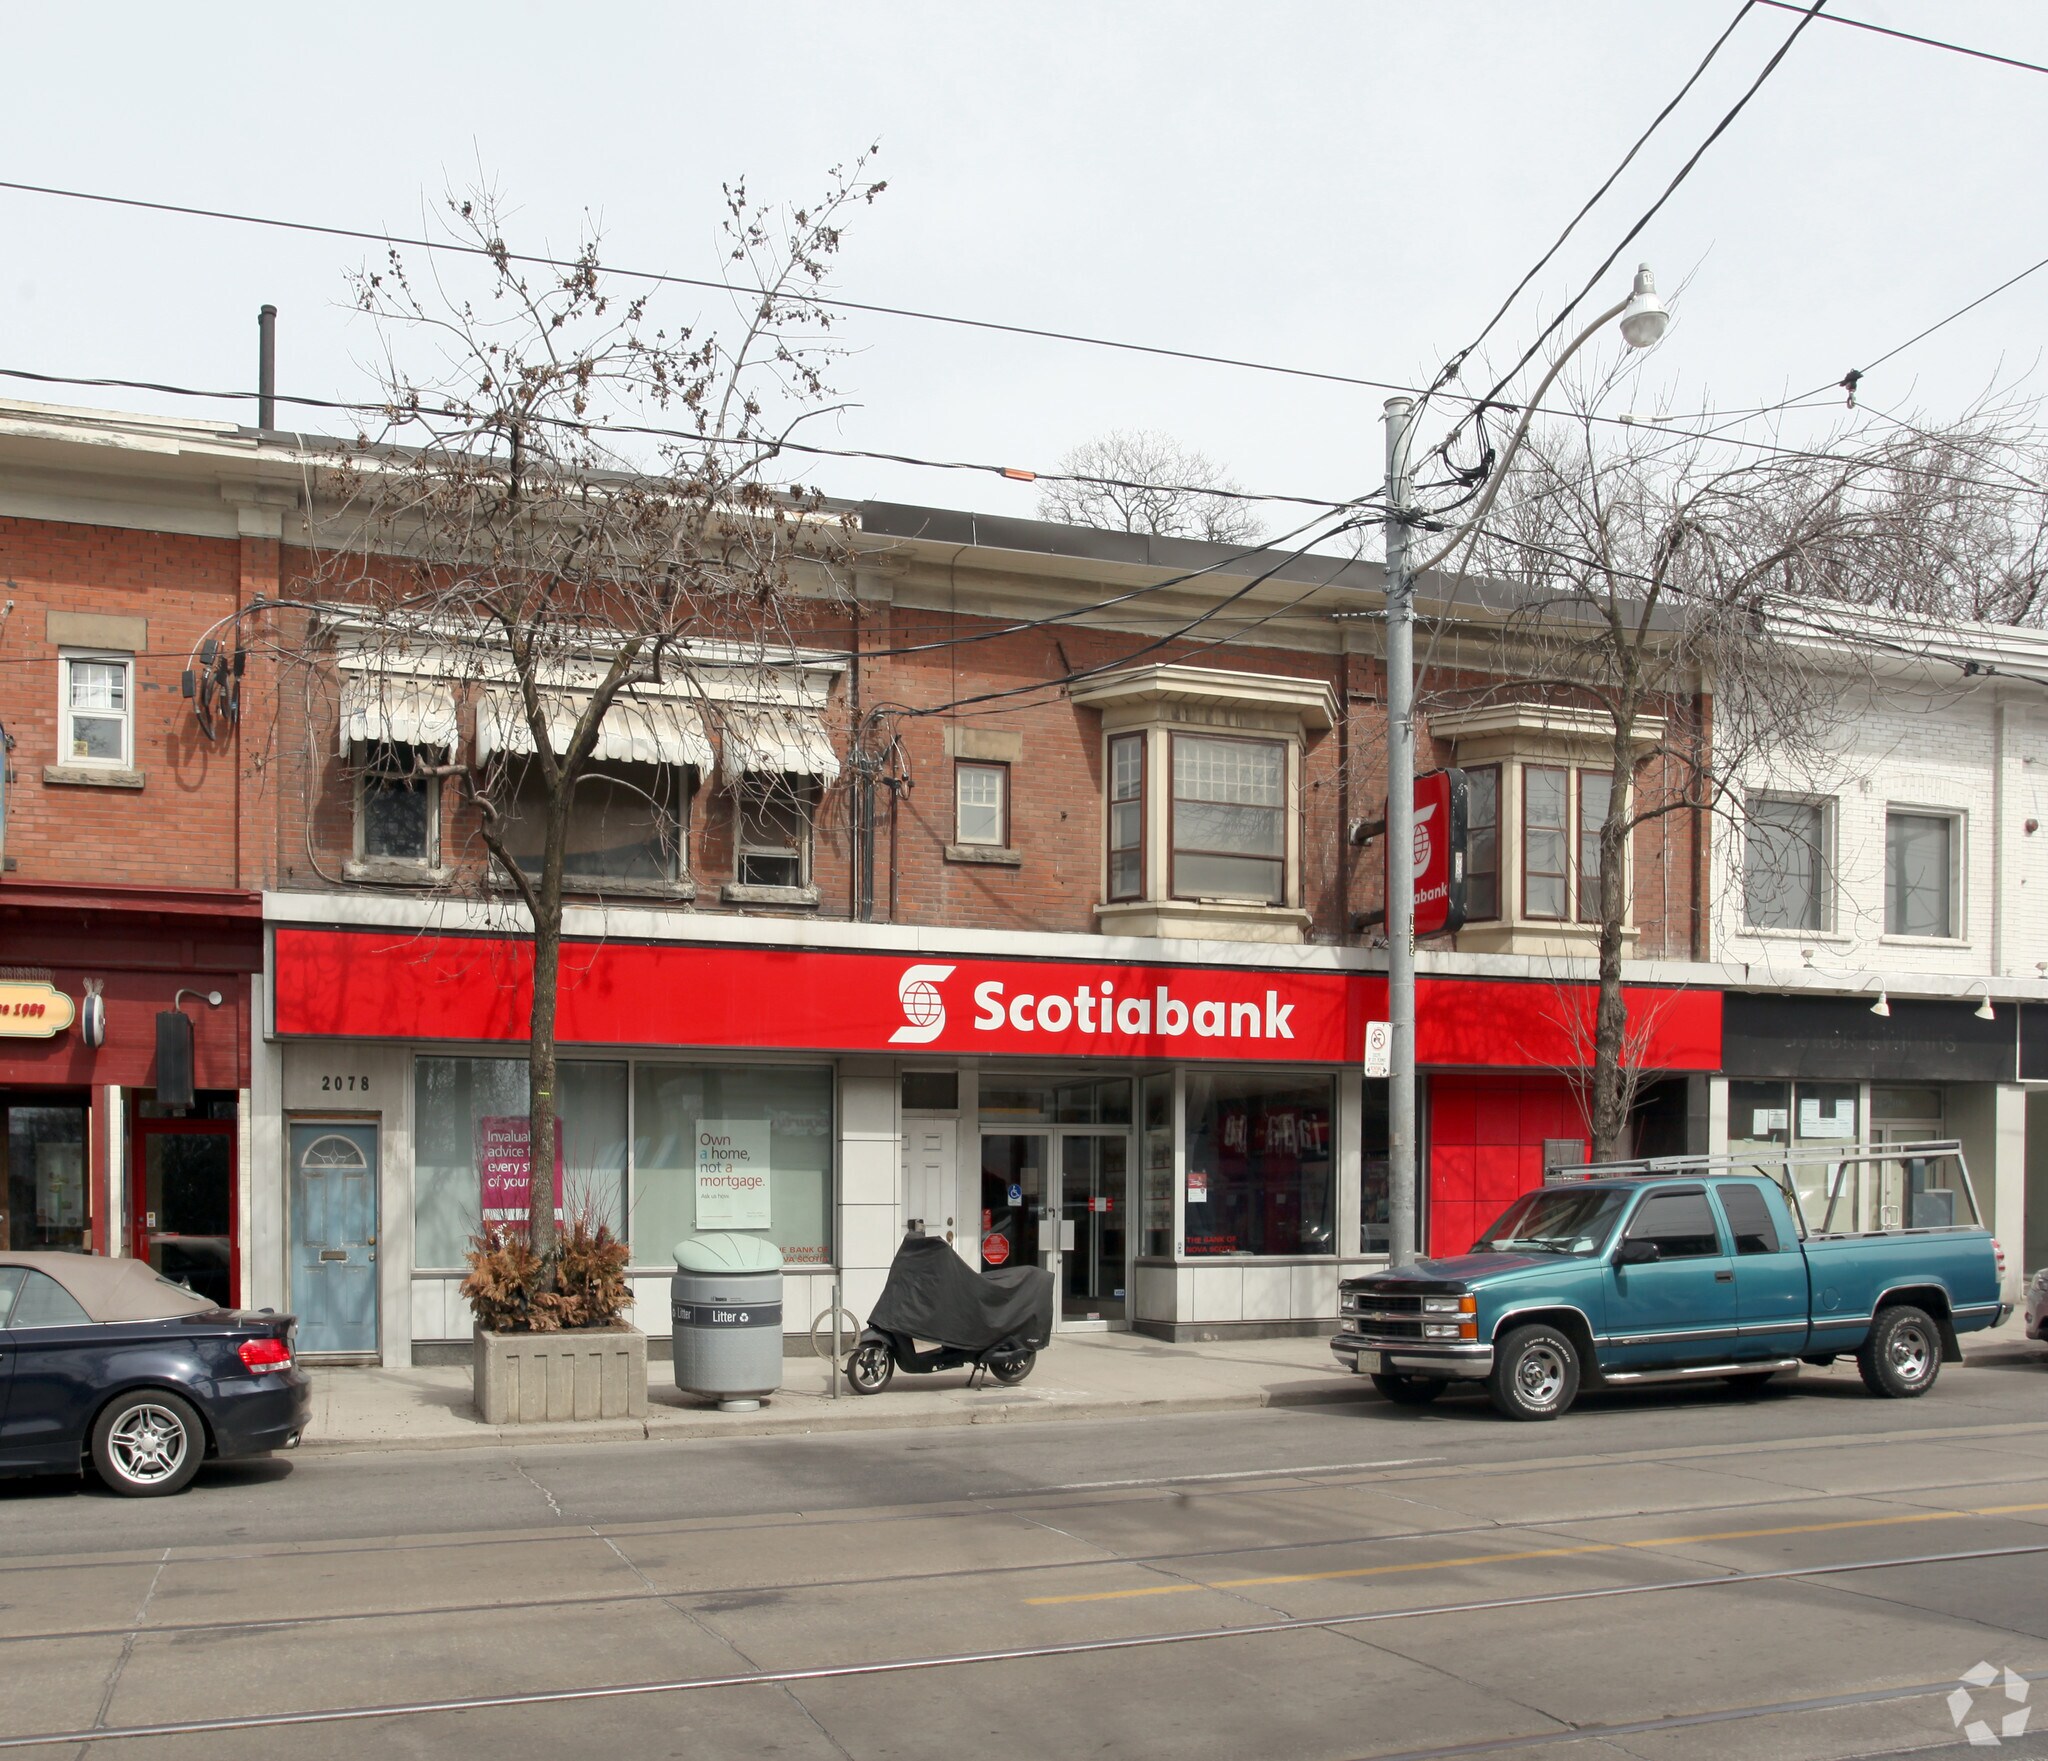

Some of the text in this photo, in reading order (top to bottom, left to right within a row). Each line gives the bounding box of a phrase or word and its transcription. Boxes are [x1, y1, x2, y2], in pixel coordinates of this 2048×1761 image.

[974, 980, 1295, 1039] Scotiabank
[321, 1075, 370, 1091] 2078
[700, 1133, 731, 1146] Own
[487, 1145, 524, 1157] advice
[700, 1146, 751, 1161] a home,
[488, 1163, 520, 1175] every
[700, 1162, 733, 1173] not a
[700, 1175, 766, 1190] mortgage.
[677, 1306, 691, 1320] Litter
[712, 1309, 737, 1323] Litter
